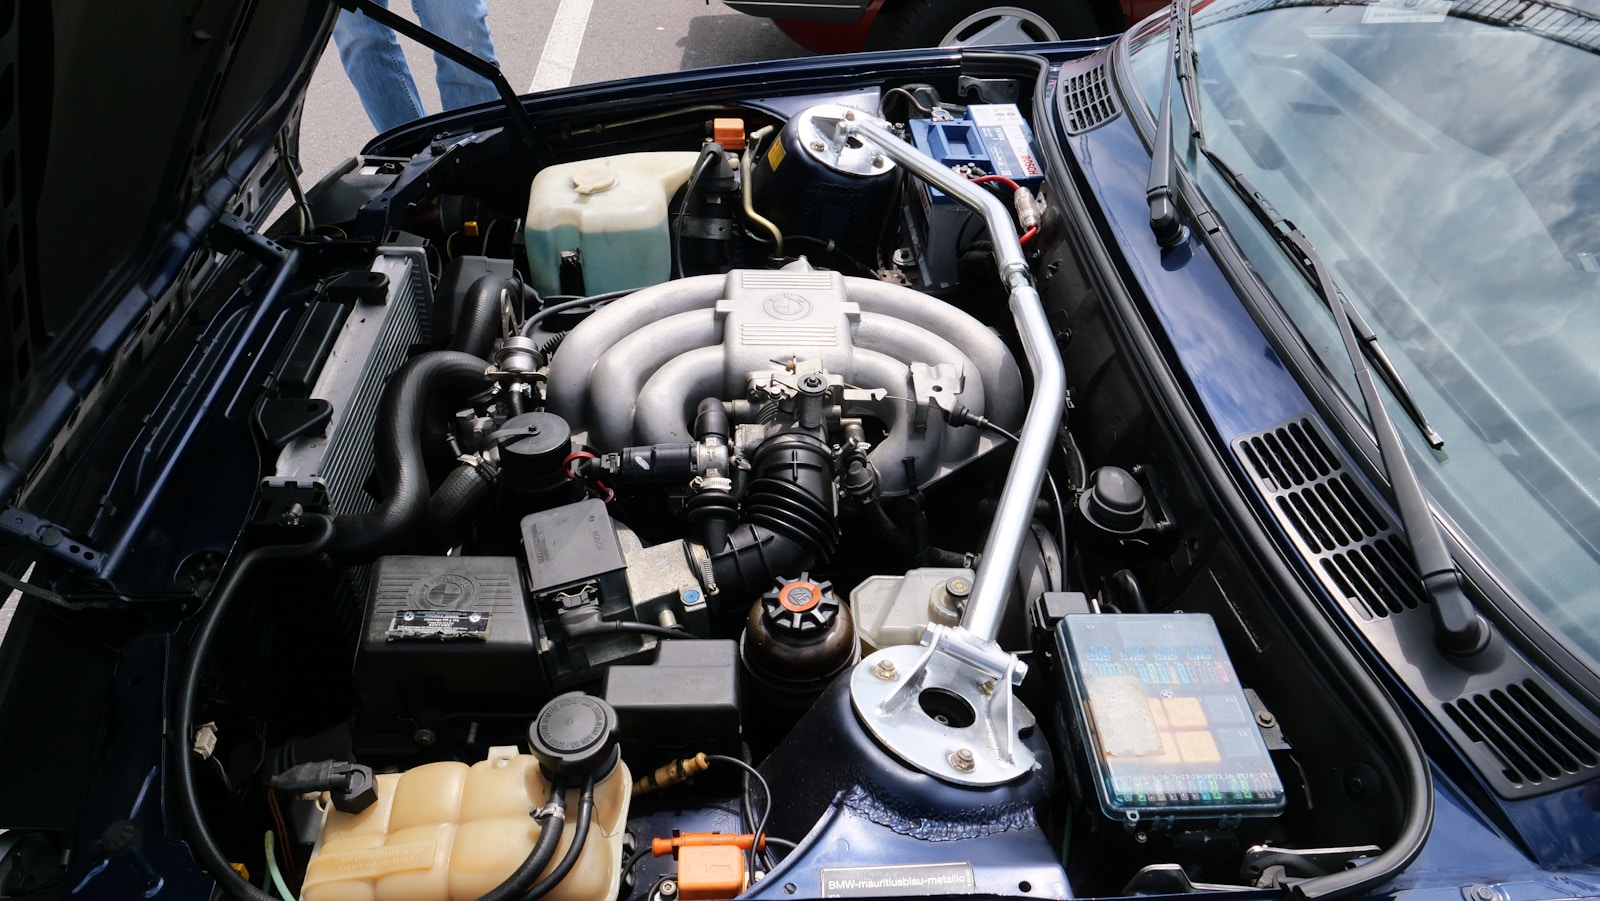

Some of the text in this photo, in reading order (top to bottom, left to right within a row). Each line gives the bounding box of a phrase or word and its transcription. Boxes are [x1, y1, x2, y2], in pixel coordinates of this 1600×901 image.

[1021, 155, 1039, 175] BOSCH
[593, 531, 605, 551] BOSCH
[828, 874, 966, 890] BMW-mauritiusblau-metallic
